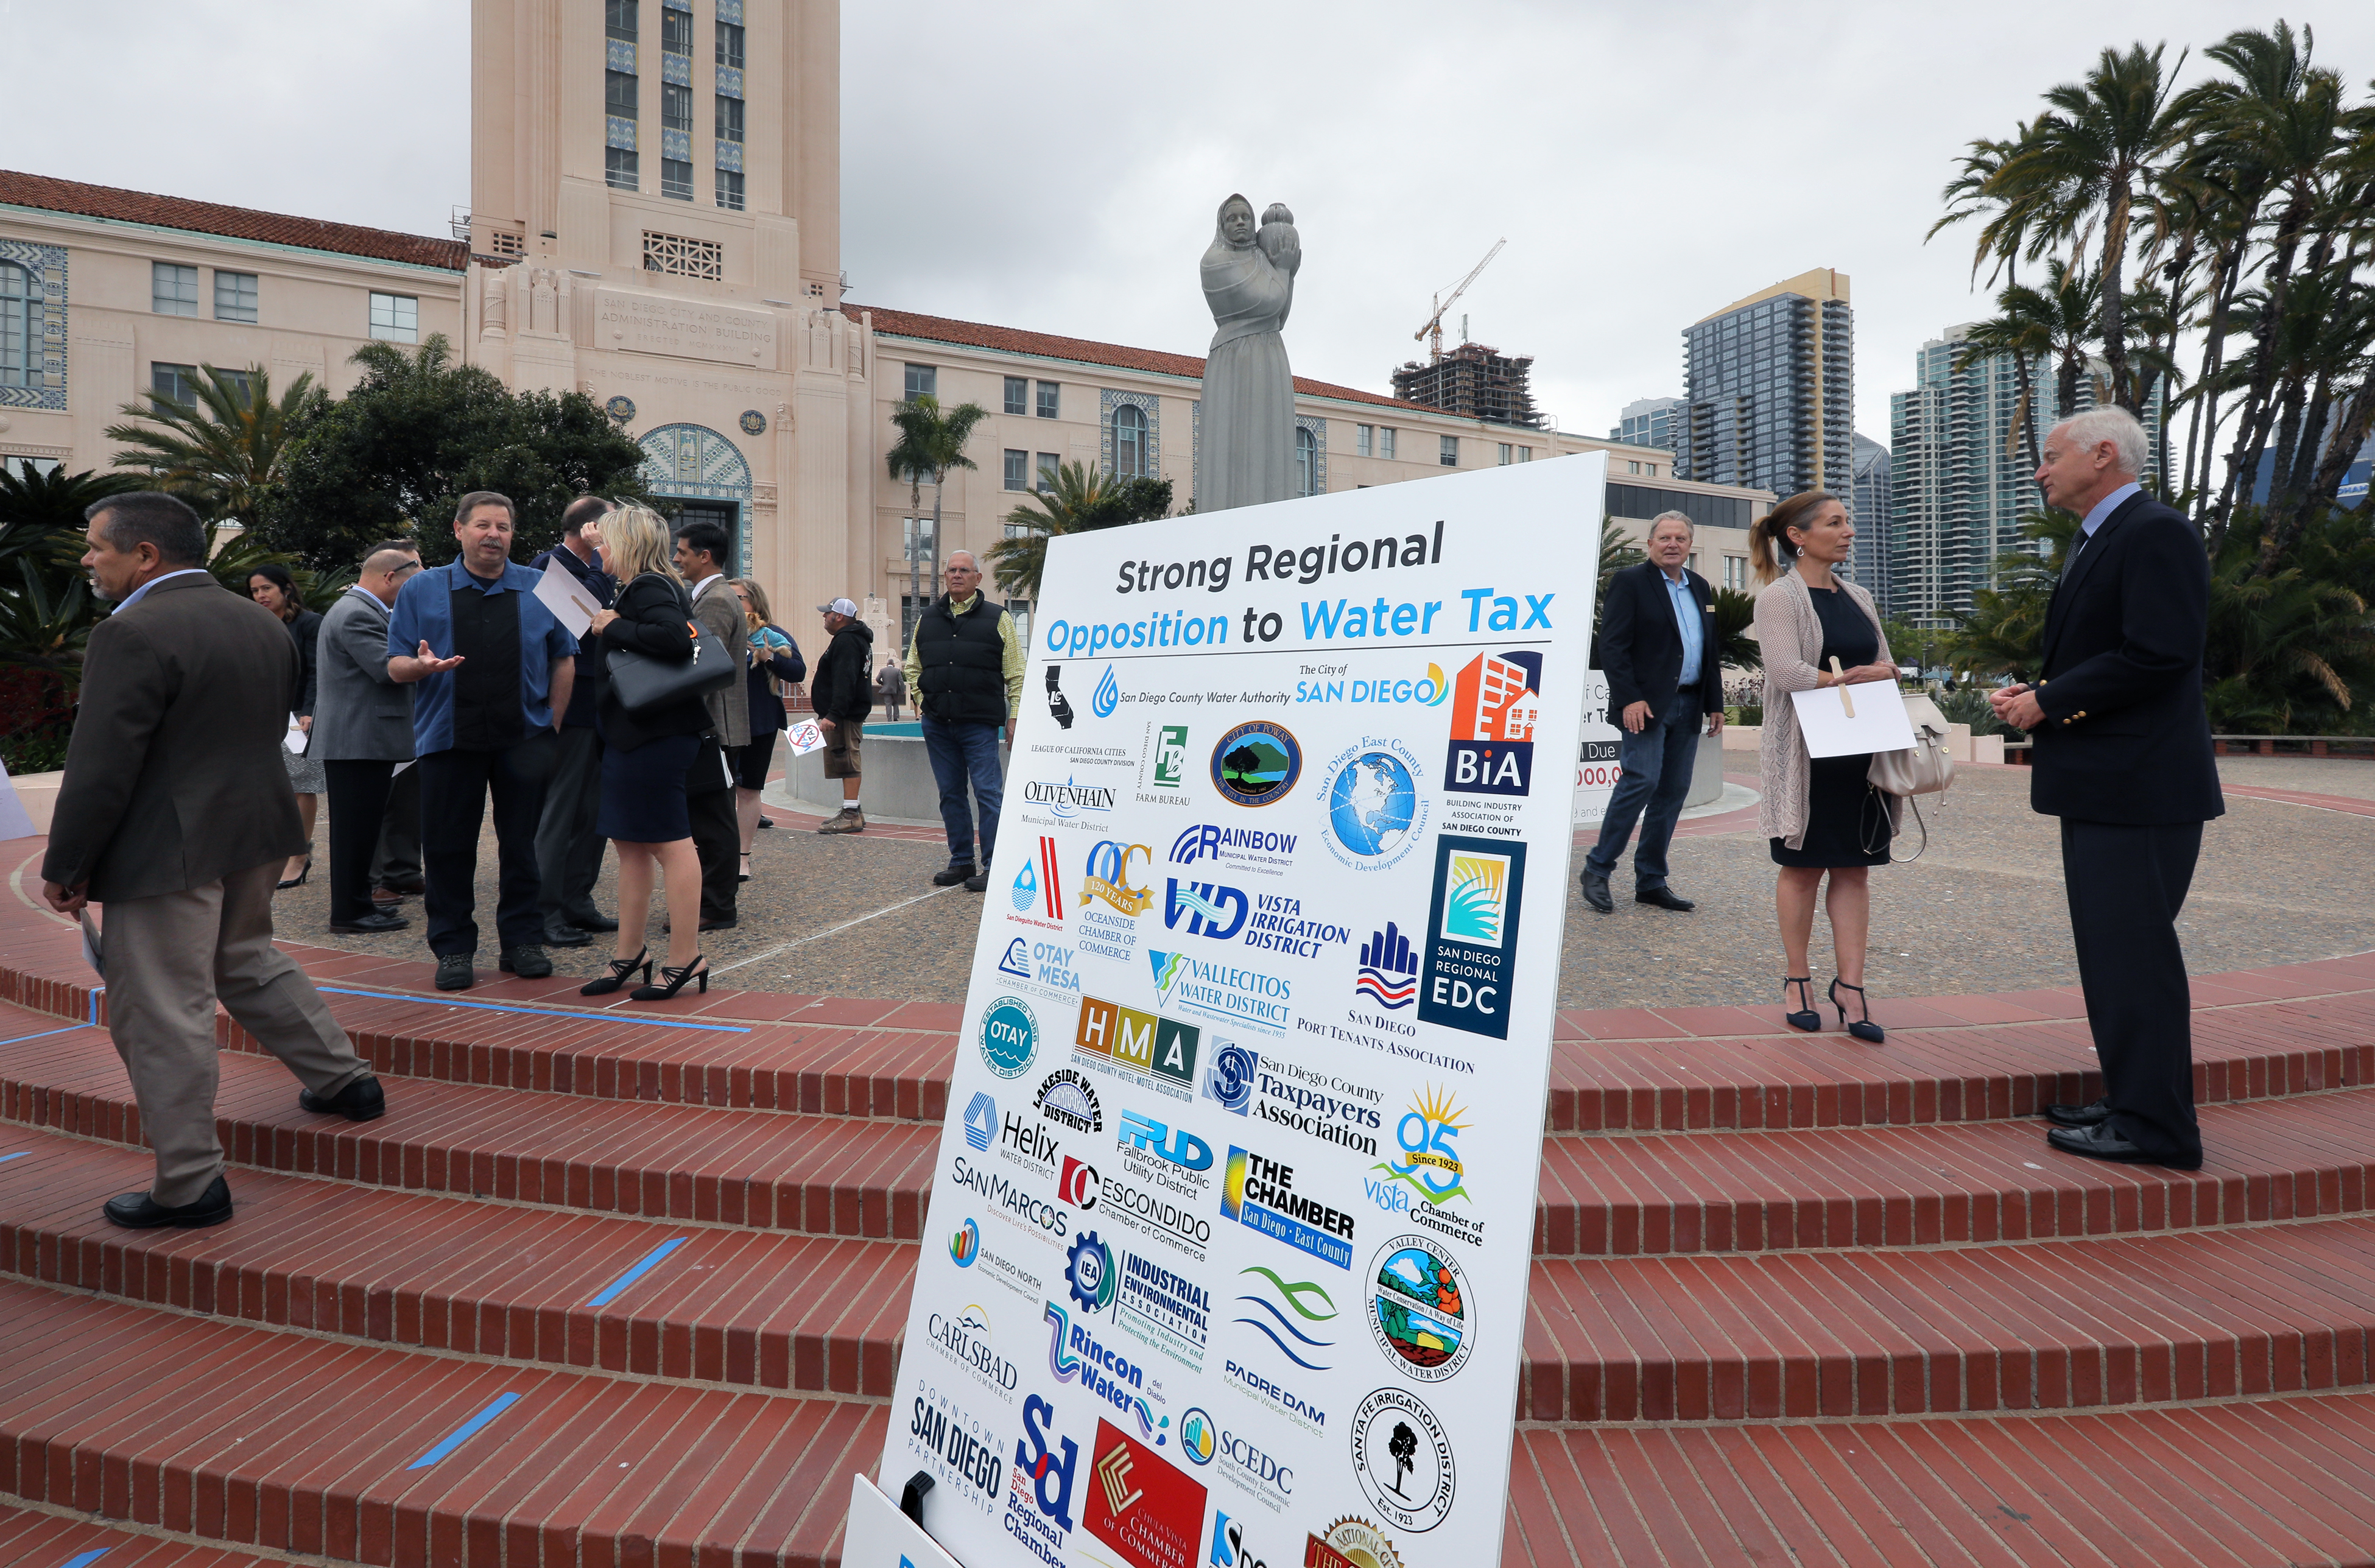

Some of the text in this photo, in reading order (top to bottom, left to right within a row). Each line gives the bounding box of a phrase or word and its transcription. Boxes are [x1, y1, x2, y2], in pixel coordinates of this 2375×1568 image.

[601, 312, 771, 343] ADMINISTRATION BUILDING
[604, 298, 768, 328] SAN DIEGO CITY AND COUNTY
[1116, 521, 1444, 594] Strong Regional
[1046, 588, 1556, 658] Opposition to Water Tax
[1300, 664, 1348, 677] The City of
[1121, 691, 1291, 706] San Diego County Water Authority
[1296, 679, 1435, 703] SAN DIEGO
[1031, 745, 1054, 753] LEAGUE
[1064, 746, 1103, 756] CALIFORNIA
[1104, 748, 1127, 757] CITIES
[1226, 726, 1246, 744] CITY
[1263, 725, 1290, 743] POWAY
[1588, 743, 1616, 758] Due
[1317, 736, 1424, 801] San Diego East County
[1025, 781, 1116, 810] OLIVENHAIN
[1136, 793, 1191, 806] FARM BUREAU
[1446, 800, 1522, 812] BUILDING INDUSTRY
[1021, 815, 1108, 832] Municipal Water District
[1442, 822, 1522, 837] SAN DIEGO COUNTY
[1451, 811, 1514, 823] ASSOCIATION OF
[1198, 824, 1297, 860] RAINBOW
[1321, 800, 1429, 871] Economic Development Council
[1091, 881, 1133, 911] 120 YEARS
[1258, 894, 1301, 916] VISTA
[1015, 916, 1033, 925] Dieguito
[1033, 919, 1046, 927] Water
[1047, 922, 1063, 931] District
[1079, 926, 1136, 946] CHAMBER OF
[1085, 912, 1135, 930] OCEANSIDE
[1250, 912, 1351, 944] IRRIGATION
[1034, 943, 1074, 968] OTAY
[1079, 940, 1131, 961] COMMERCE
[1245, 930, 1323, 958] DISTRICT
[1438, 946, 1501, 966] SAN DIEGO
[1038, 965, 1080, 993] MESA
[1191, 958, 1290, 1000] VALLECITOS
[1436, 961, 1498, 982] REGIONAL
[1180, 982, 1290, 1023] WATER DISTRICT
[1432, 977, 1497, 1014] EDC
[991, 1021, 1028, 1047] OTAY
[1259, 1056, 1384, 1105] San Diego County
[1032, 1069, 1102, 1133] LAKESIDE WATER
[1258, 1072, 1381, 1129] Taxpayers
[1044, 1104, 1091, 1134] DISTRICT
[1253, 1099, 1377, 1156] Association
[1002, 1111, 1060, 1167] Helix
[1001, 1148, 1054, 1181] WATER DISTRICT
[1117, 1142, 1210, 1189] Fallbrook Public
[1124, 1159, 1198, 1200] Utility District
[1249, 1153, 1293, 1189] THE
[1412, 1154, 1458, 1172] Since 1923
[1102, 1177, 1210, 1242] ESCONDIDO
[1245, 1178, 1355, 1240] CHAMBER
[1410, 1208, 1482, 1246] Commerce
[1420, 1201, 1485, 1233] Chamber of
[1099, 1204, 1205, 1262] Chamber of Commerce
[1243, 1204, 1349, 1264] San Diego East County
[980, 1248, 1042, 1291] SAN DIEGO NORTH
[1389, 1237, 1460, 1278] VALLEY CENTER
[1127, 1253, 1211, 1313] INDUSTRIAL
[1122, 1292, 1206, 1344] ASSOCIATION
[1124, 1275, 1208, 1332] ENVIRONMENTAL
[928, 1313, 1017, 1390] CARLSBAD
[1118, 1320, 1203, 1374] Protecting the Environment
[1120, 1307, 1204, 1361] Promoting Industry and
[1368, 1298, 1469, 1379] MUNICIPAL WATER DISTRICT
[1070, 1323, 1142, 1390] Rincon
[1080, 1362, 1133, 1413] Water
[1147, 1388, 1166, 1404] Diablo
[1152, 1379, 1163, 1390] del
[911, 1396, 1001, 1499] SAN DIEGO
[1220, 1431, 1293, 1494] SCEDC
[1355, 1393, 1451, 1517] SANTA FE IRRIGATION DISTRICT
[1011, 1480, 1034, 1504] Diego
[1013, 1467, 1027, 1486] San
[1218, 1466, 1281, 1513] Development Council
[1219, 1455, 1290, 1507] South County Economic
[1008, 1491, 1063, 1550] Regional
[1377, 1497, 1413, 1525] Est. 1923
